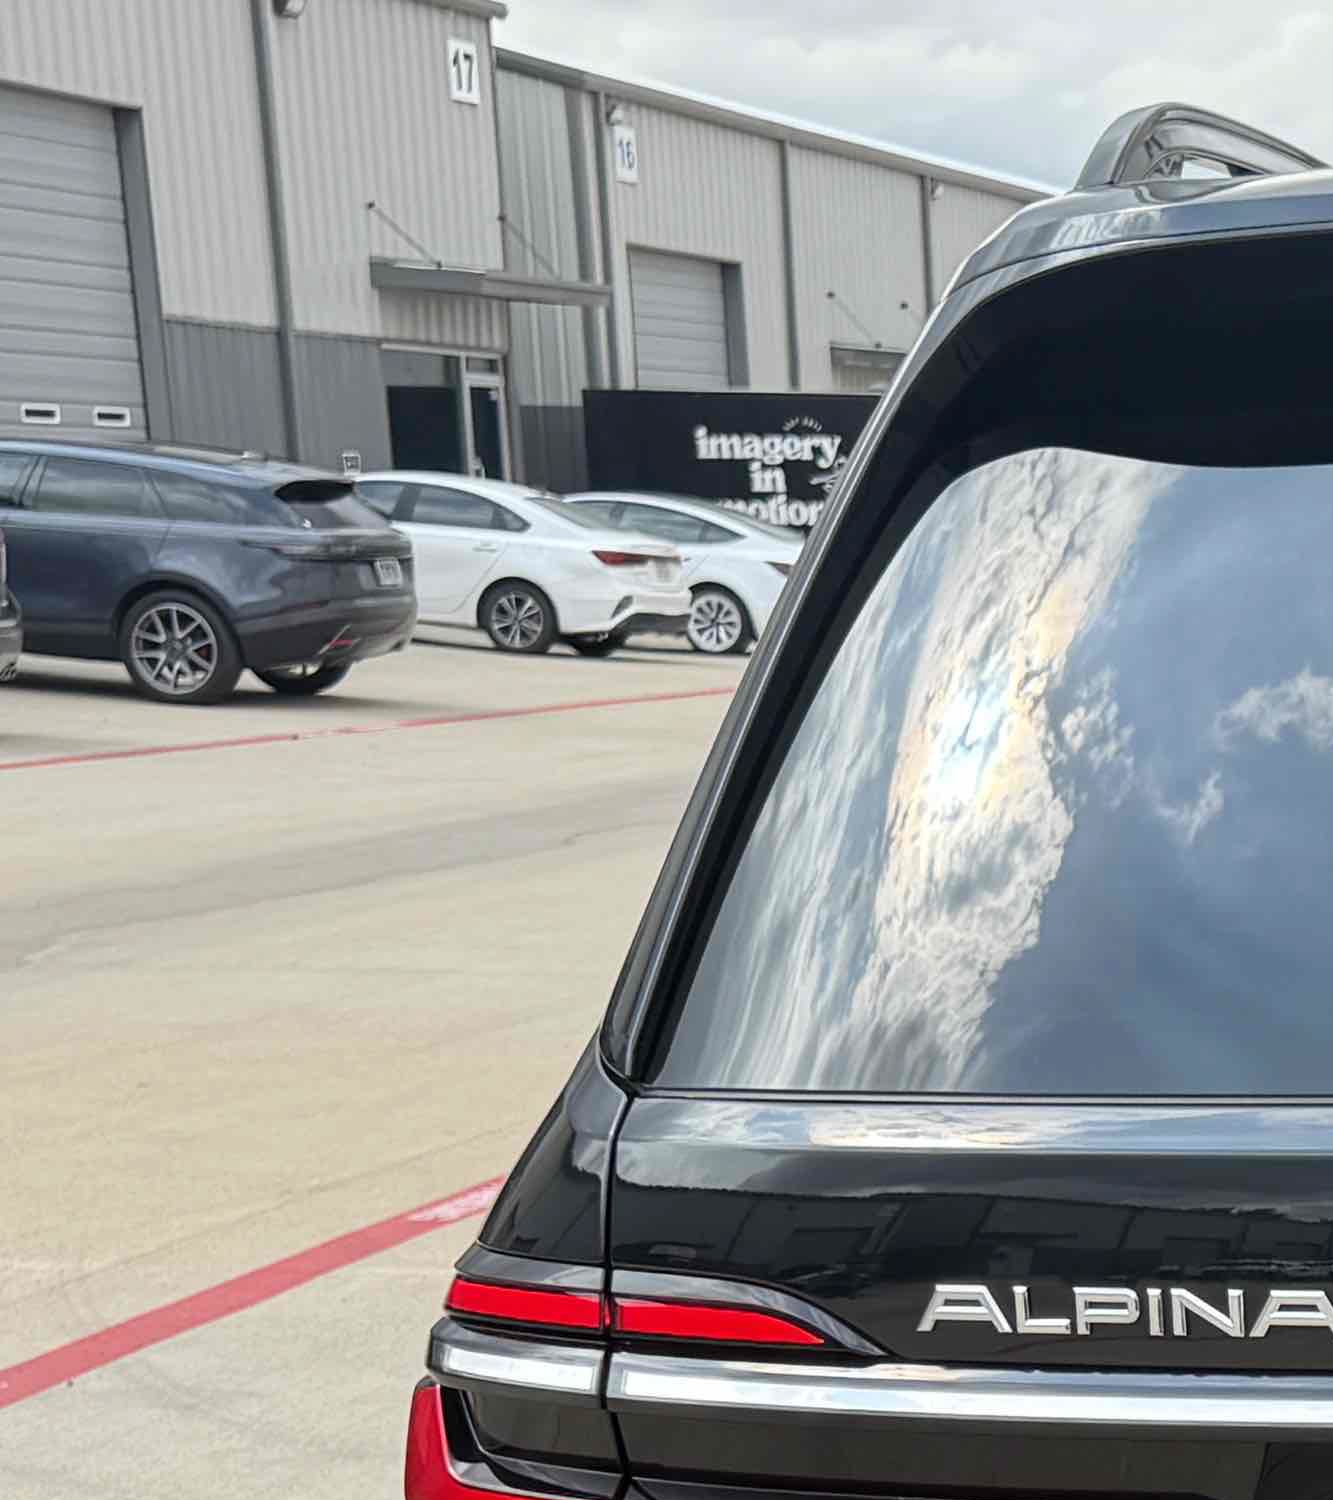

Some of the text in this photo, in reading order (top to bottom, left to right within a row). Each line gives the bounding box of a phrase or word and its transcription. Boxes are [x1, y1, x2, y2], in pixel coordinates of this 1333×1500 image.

[452, 48, 474, 94] 17
[618, 138, 636, 170] 16
[693, 424, 842, 469] imagery
[749, 461, 788, 493] in
